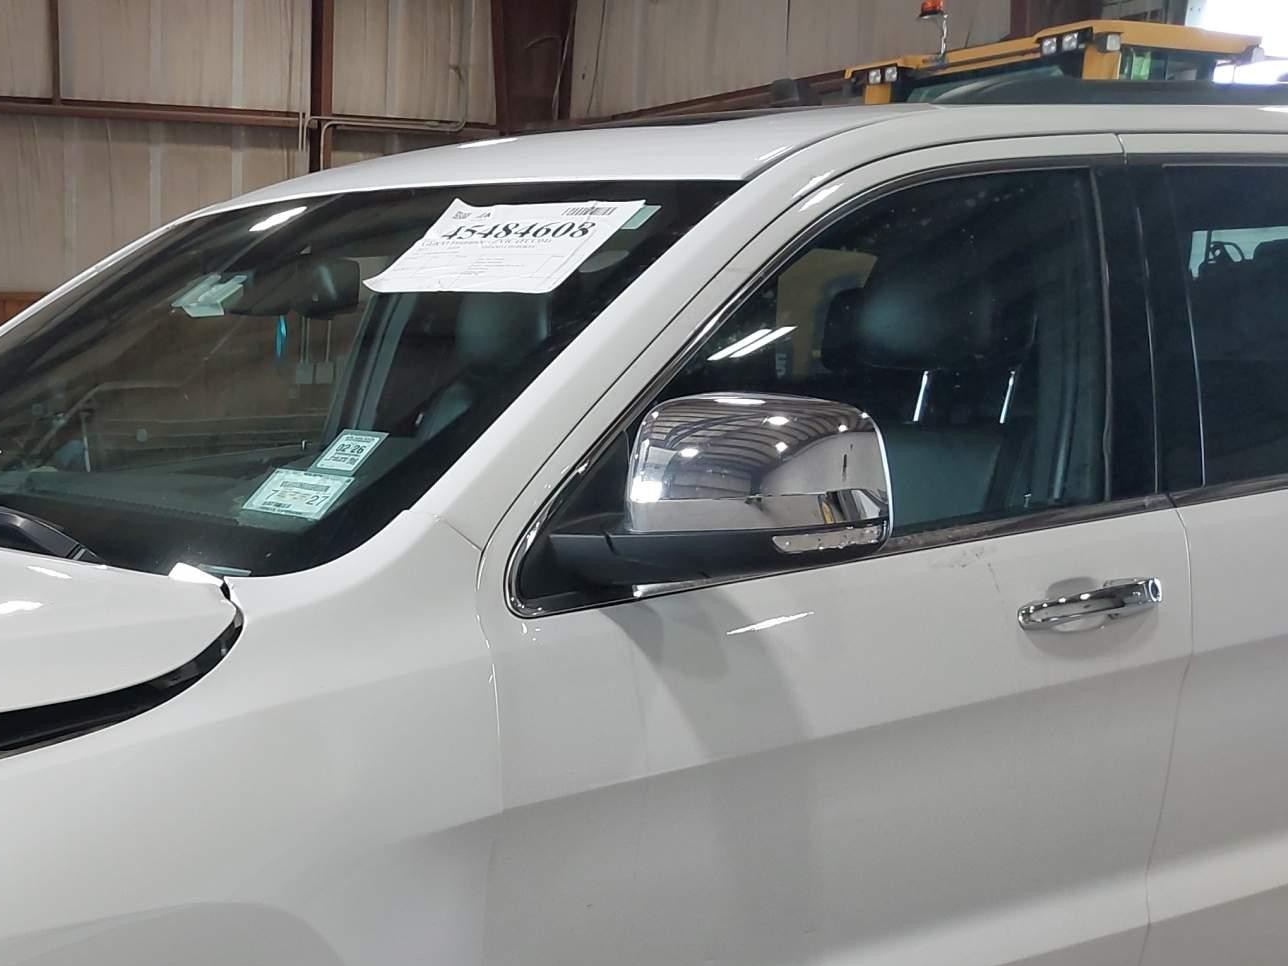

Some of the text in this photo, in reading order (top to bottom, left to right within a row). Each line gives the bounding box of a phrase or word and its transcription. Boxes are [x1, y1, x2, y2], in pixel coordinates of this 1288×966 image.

[441, 220, 598, 241] 45484608
[350, 444, 365, 454] 26
[306, 495, 329, 506] 27
